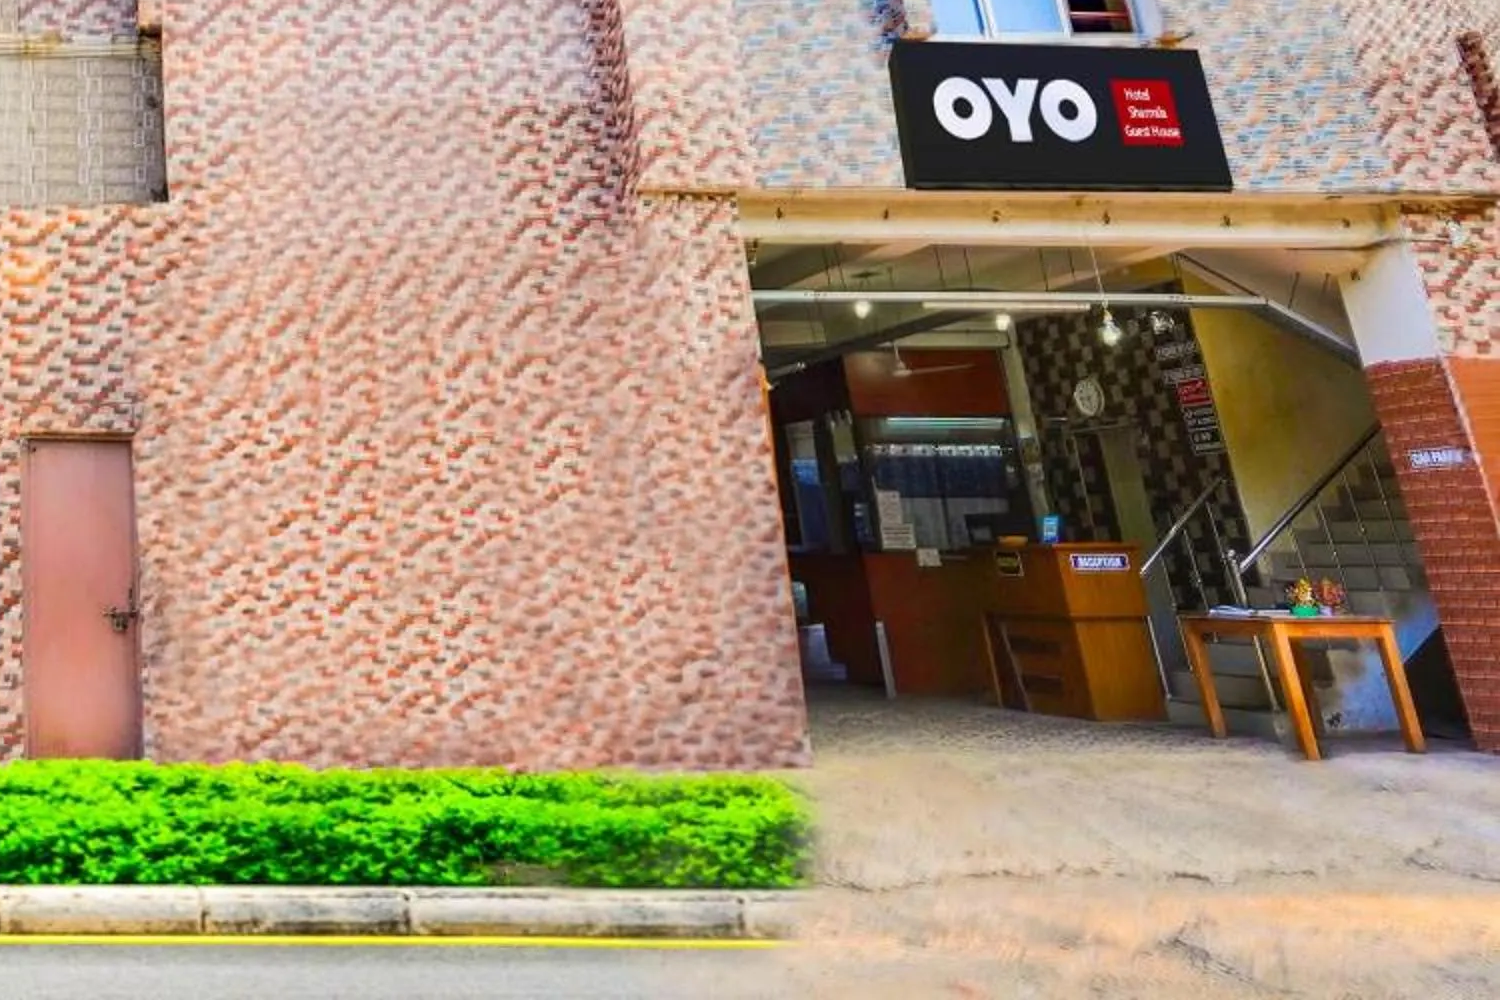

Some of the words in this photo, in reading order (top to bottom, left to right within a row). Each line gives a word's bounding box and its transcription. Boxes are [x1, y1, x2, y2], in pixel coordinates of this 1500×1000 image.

[1123, 87, 1151, 101] Hotel
[933, 76, 1097, 142] OYO
[1124, 124, 1151, 137] Guest
[1151, 125, 1182, 138] House
